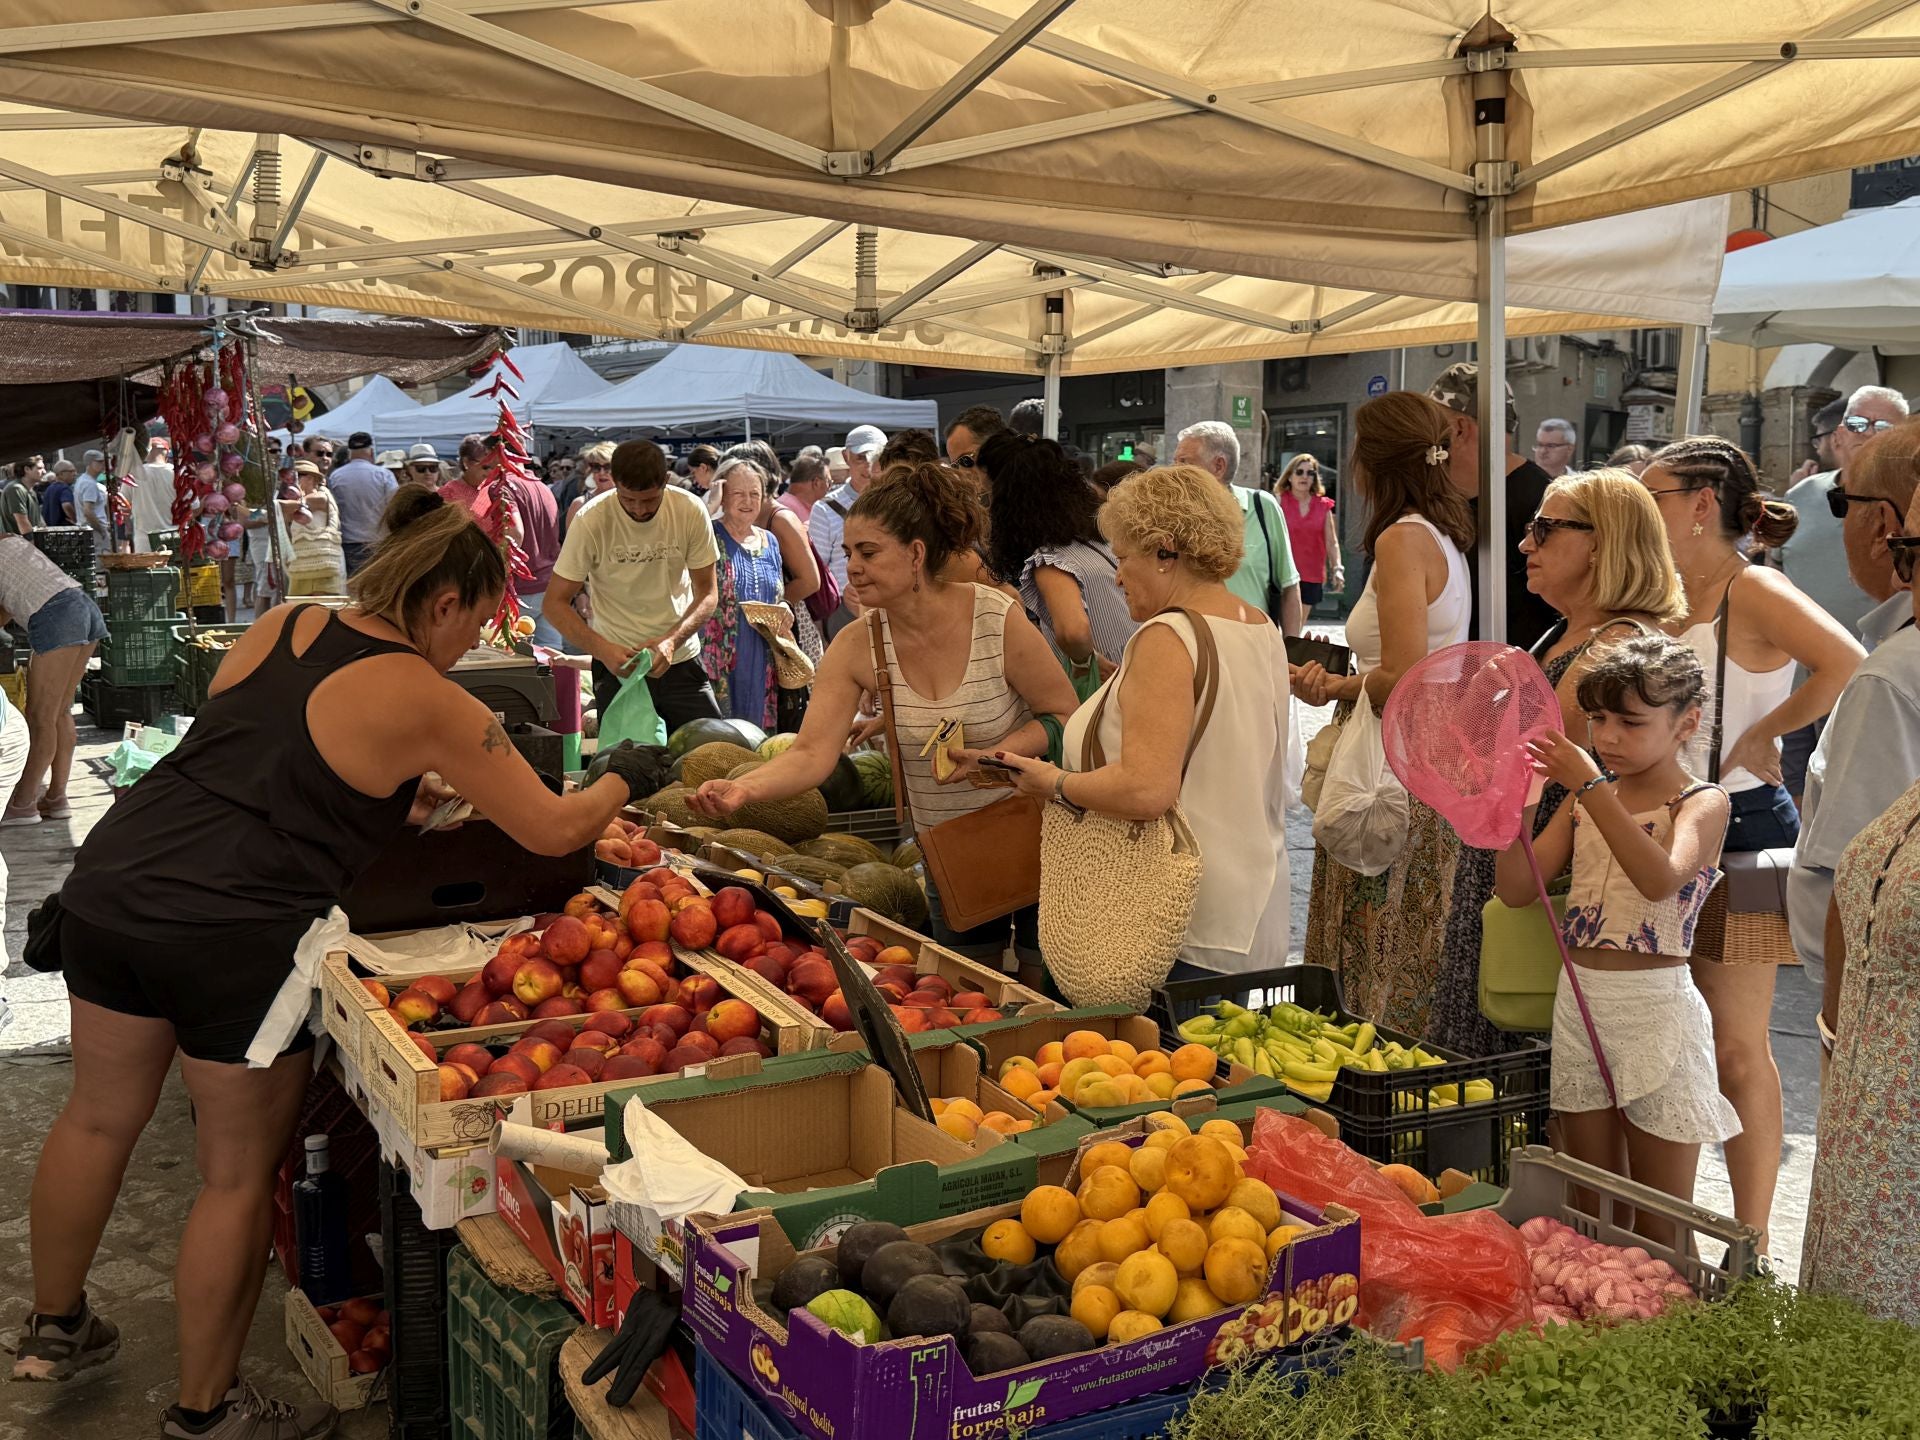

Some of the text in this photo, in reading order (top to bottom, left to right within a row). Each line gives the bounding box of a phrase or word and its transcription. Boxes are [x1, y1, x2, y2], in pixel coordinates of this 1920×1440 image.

[499, 1176, 521, 1220] Prince
[695, 1271, 732, 1312] torrebaja
[1071, 1356, 1178, 1394] www.frutastorrebaja.es
[782, 1383, 835, 1440] Natural Quality
[953, 1401, 1001, 1421] frutas
